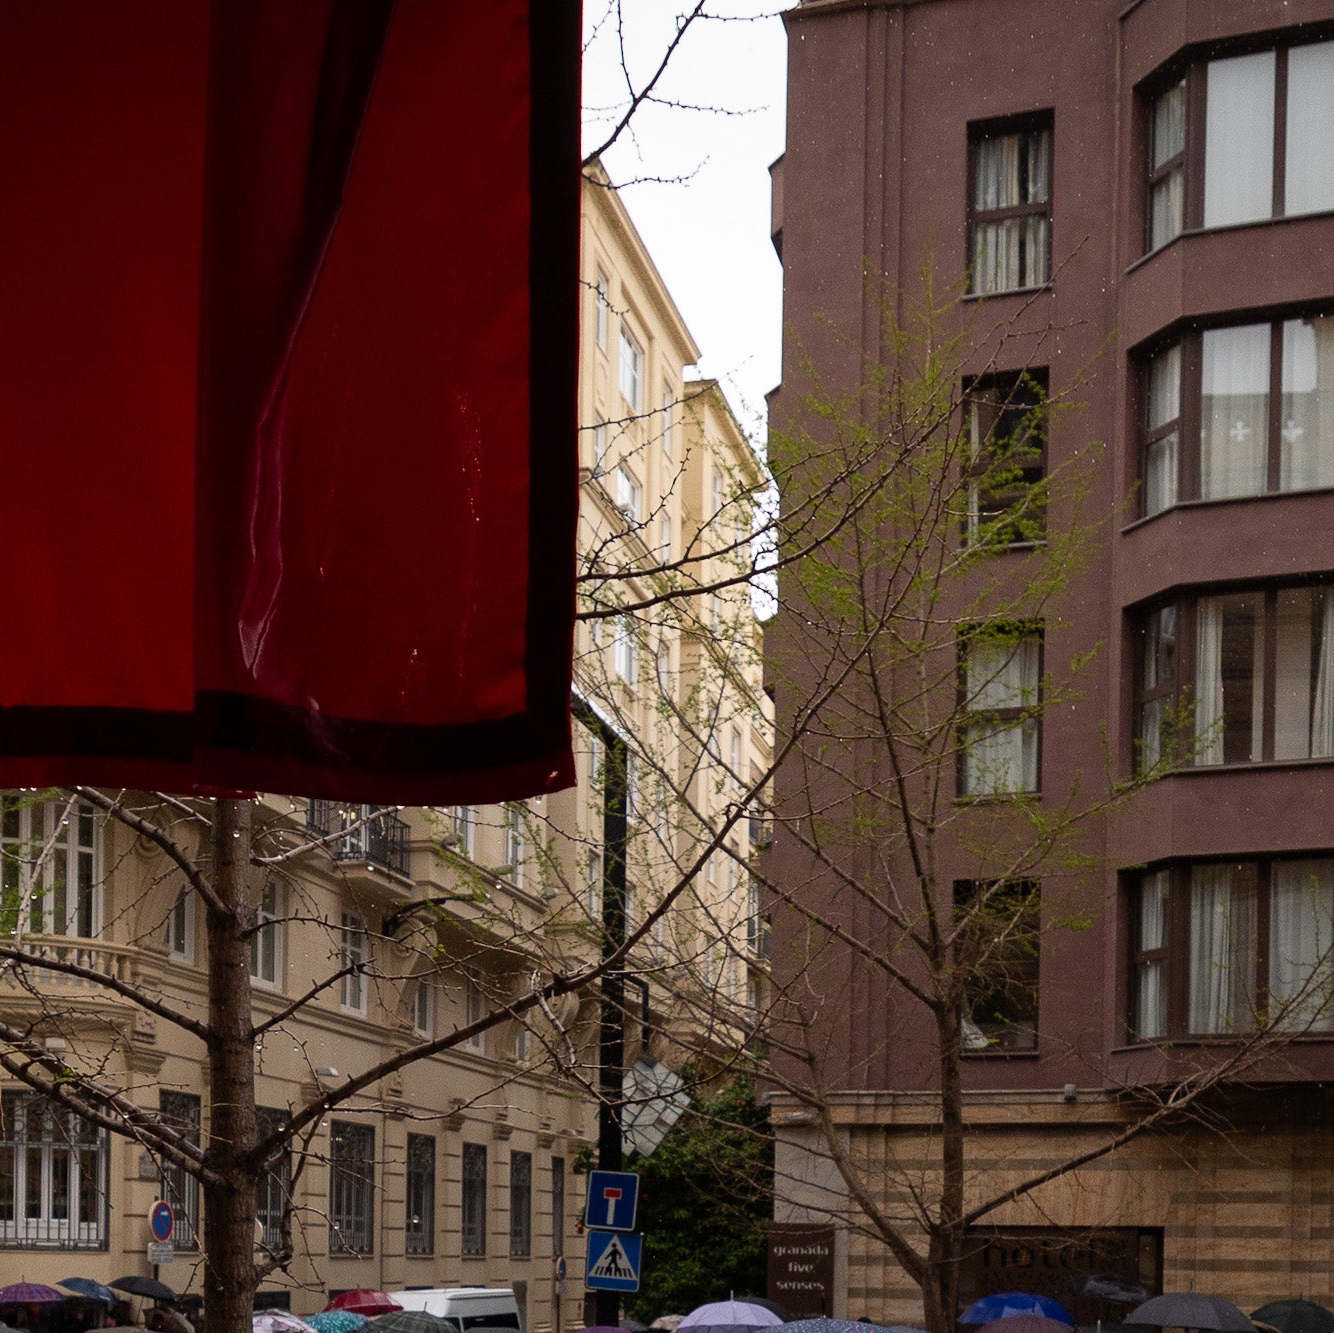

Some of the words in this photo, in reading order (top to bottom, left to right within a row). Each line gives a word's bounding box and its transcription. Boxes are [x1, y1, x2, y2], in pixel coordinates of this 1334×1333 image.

[773, 1244, 829, 1257] granada
[787, 1261, 815, 1273] five
[775, 1279, 825, 1291] senses
